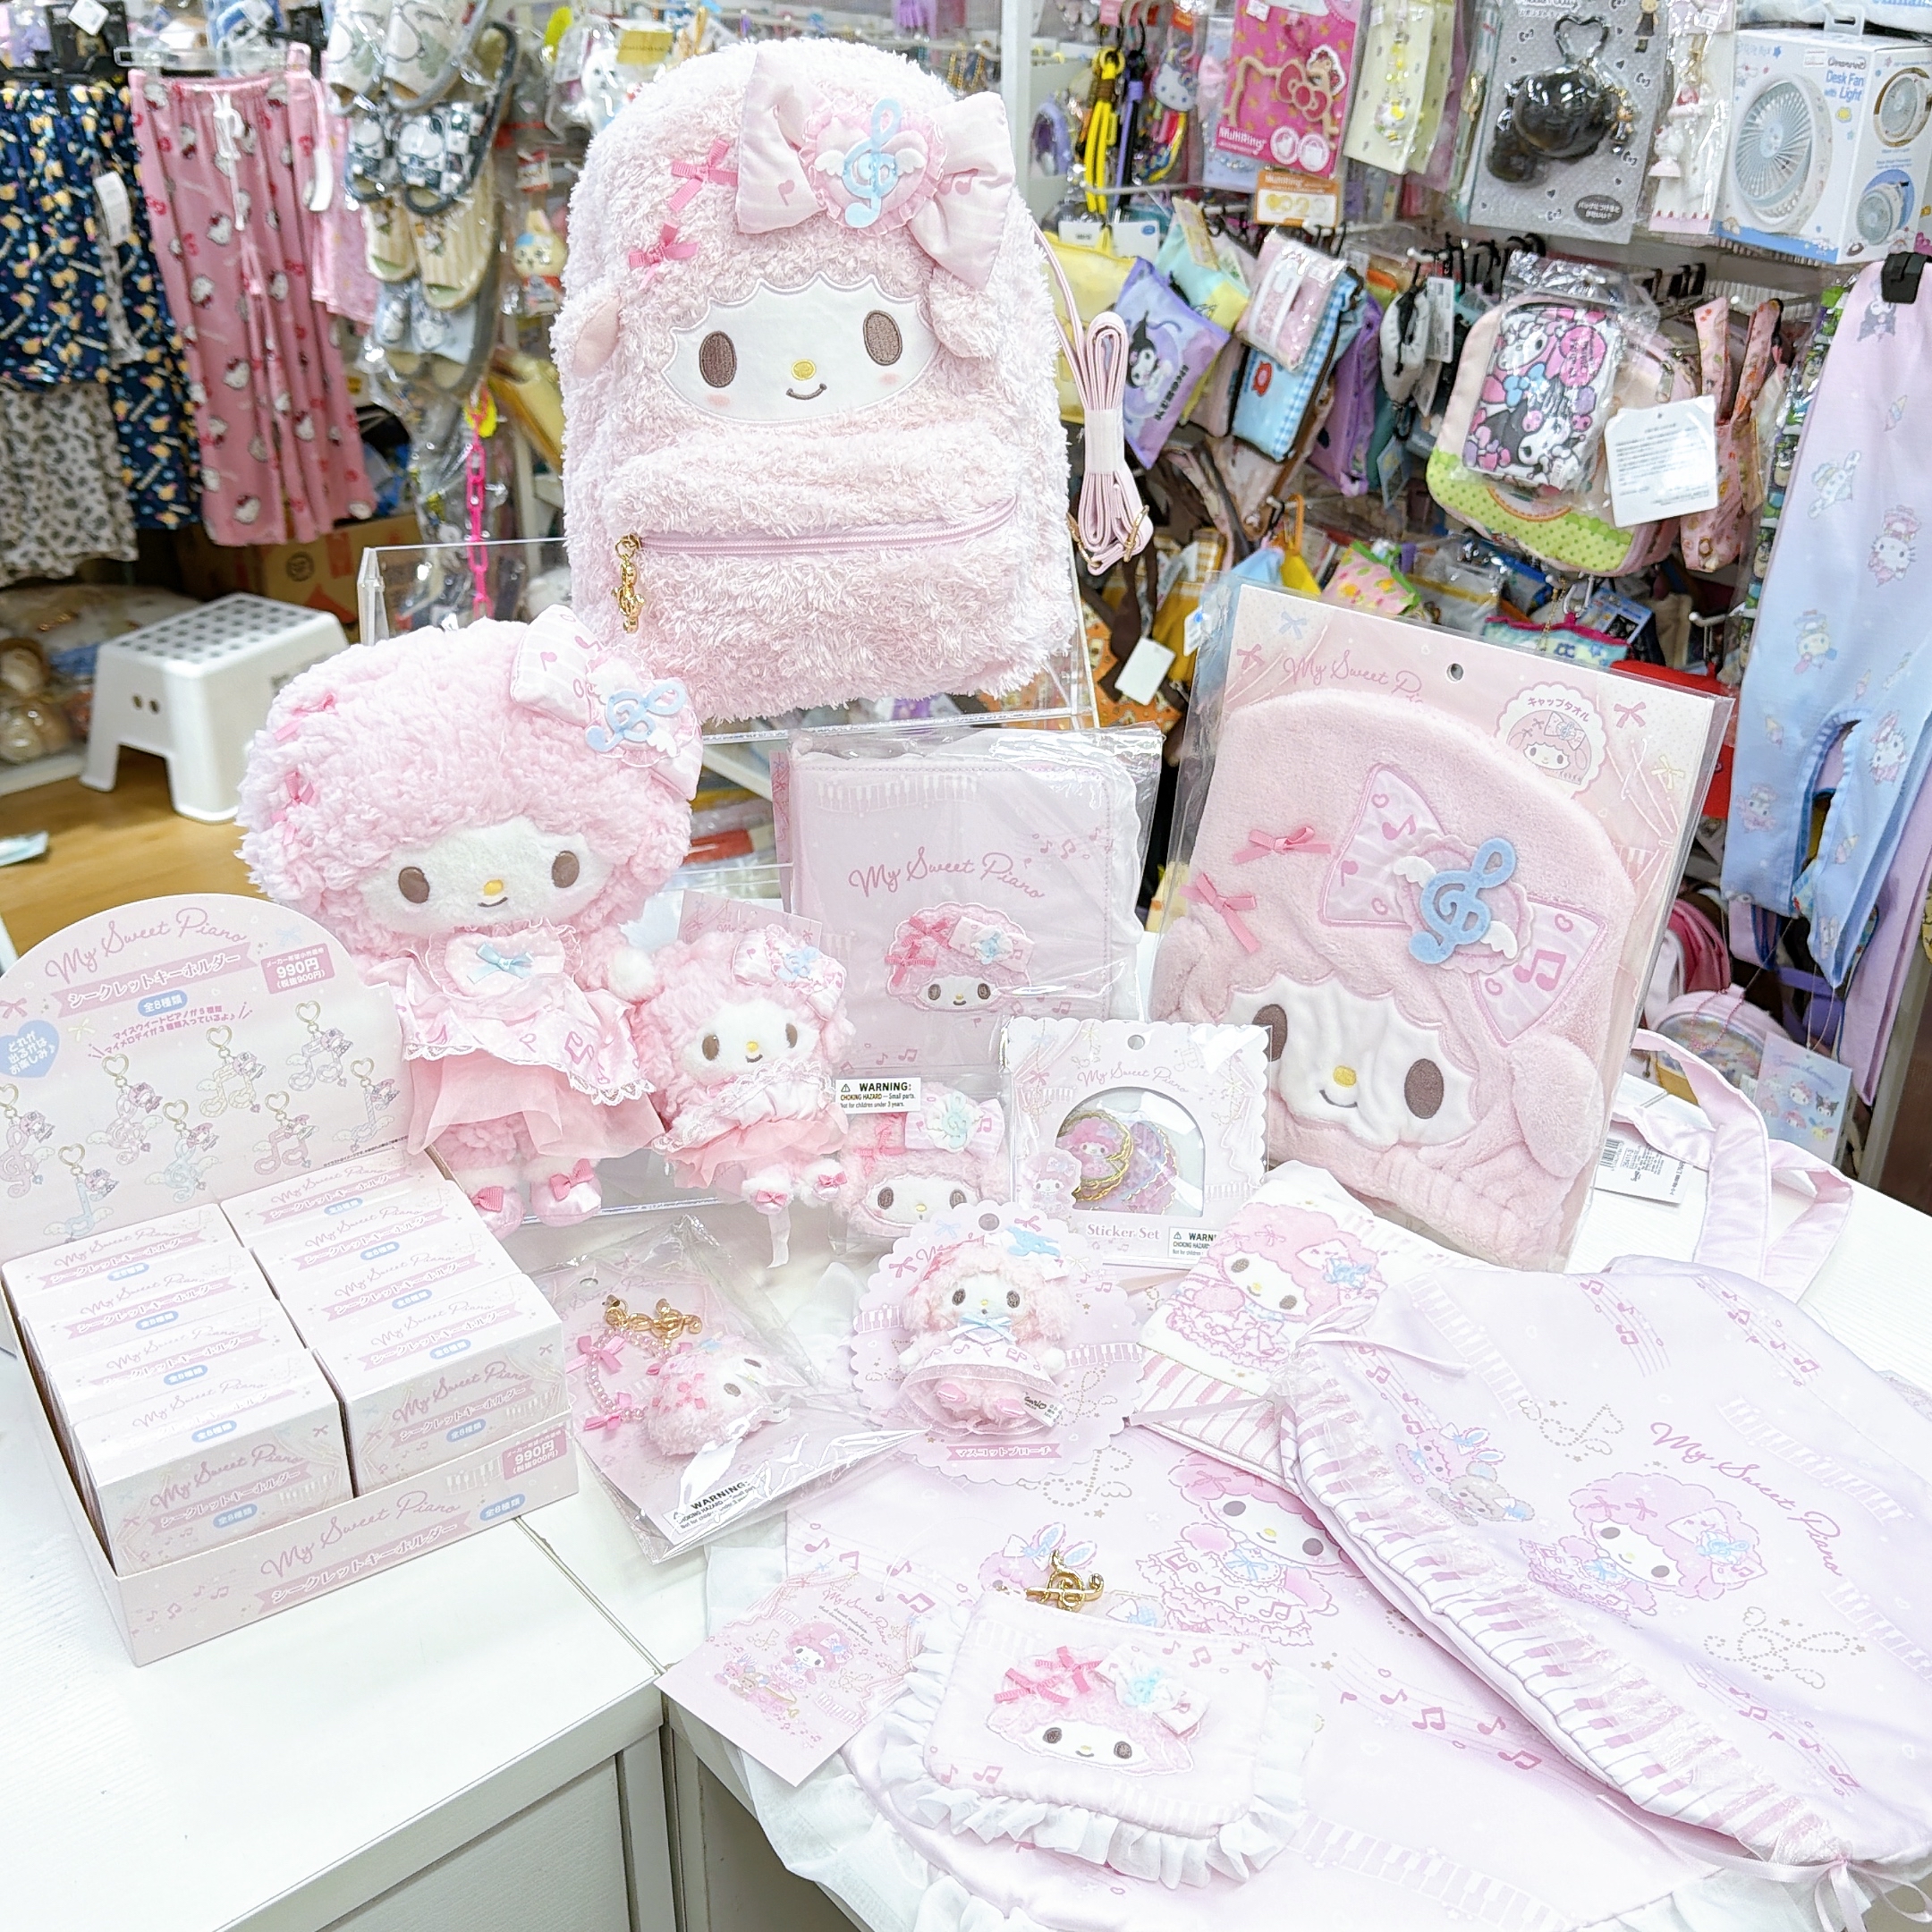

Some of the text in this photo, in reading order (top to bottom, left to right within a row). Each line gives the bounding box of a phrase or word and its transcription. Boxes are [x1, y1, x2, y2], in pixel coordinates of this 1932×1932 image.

[1826, 70, 1864, 87] Desk Fan
[1839, 87, 1862, 103] Light
[1283, 656, 1326, 688] My
[1330, 650, 1390, 686] Sweet
[1526, 696, 1590, 723] キャップタオル
[849, 846, 1046, 900] My Sweet Piano
[45, 907, 248, 985] My Sweet Piano
[68, 953, 242, 1008] シークレットキーホルダー
[276, 956, 321, 979] 990円
[142, 994, 182, 1013] 全8種類
[859, 1081, 912, 1092] WARNING:
[1076, 1062, 1190, 1093] My Sweet Piano
[862, 1093, 883, 1101] HAZARD
[1087, 1224, 1161, 1240] Sticker Set
[1188, 1232, 1217, 1242] WARN
[392, 1361, 530, 1423] My Sweet Piano
[514, 1439, 556, 1466] 990円
[954, 1444, 1053, 1459] マスコットブローチ
[148, 1443, 304, 1510] My Sweet Piano
[1649, 1421, 1843, 1577] My Sweet Piano
[259, 1489, 462, 1579] My Sweet Piano
[270, 1522, 458, 1605] シークレットキーホルダー
[822, 1589, 845, 1606] My
